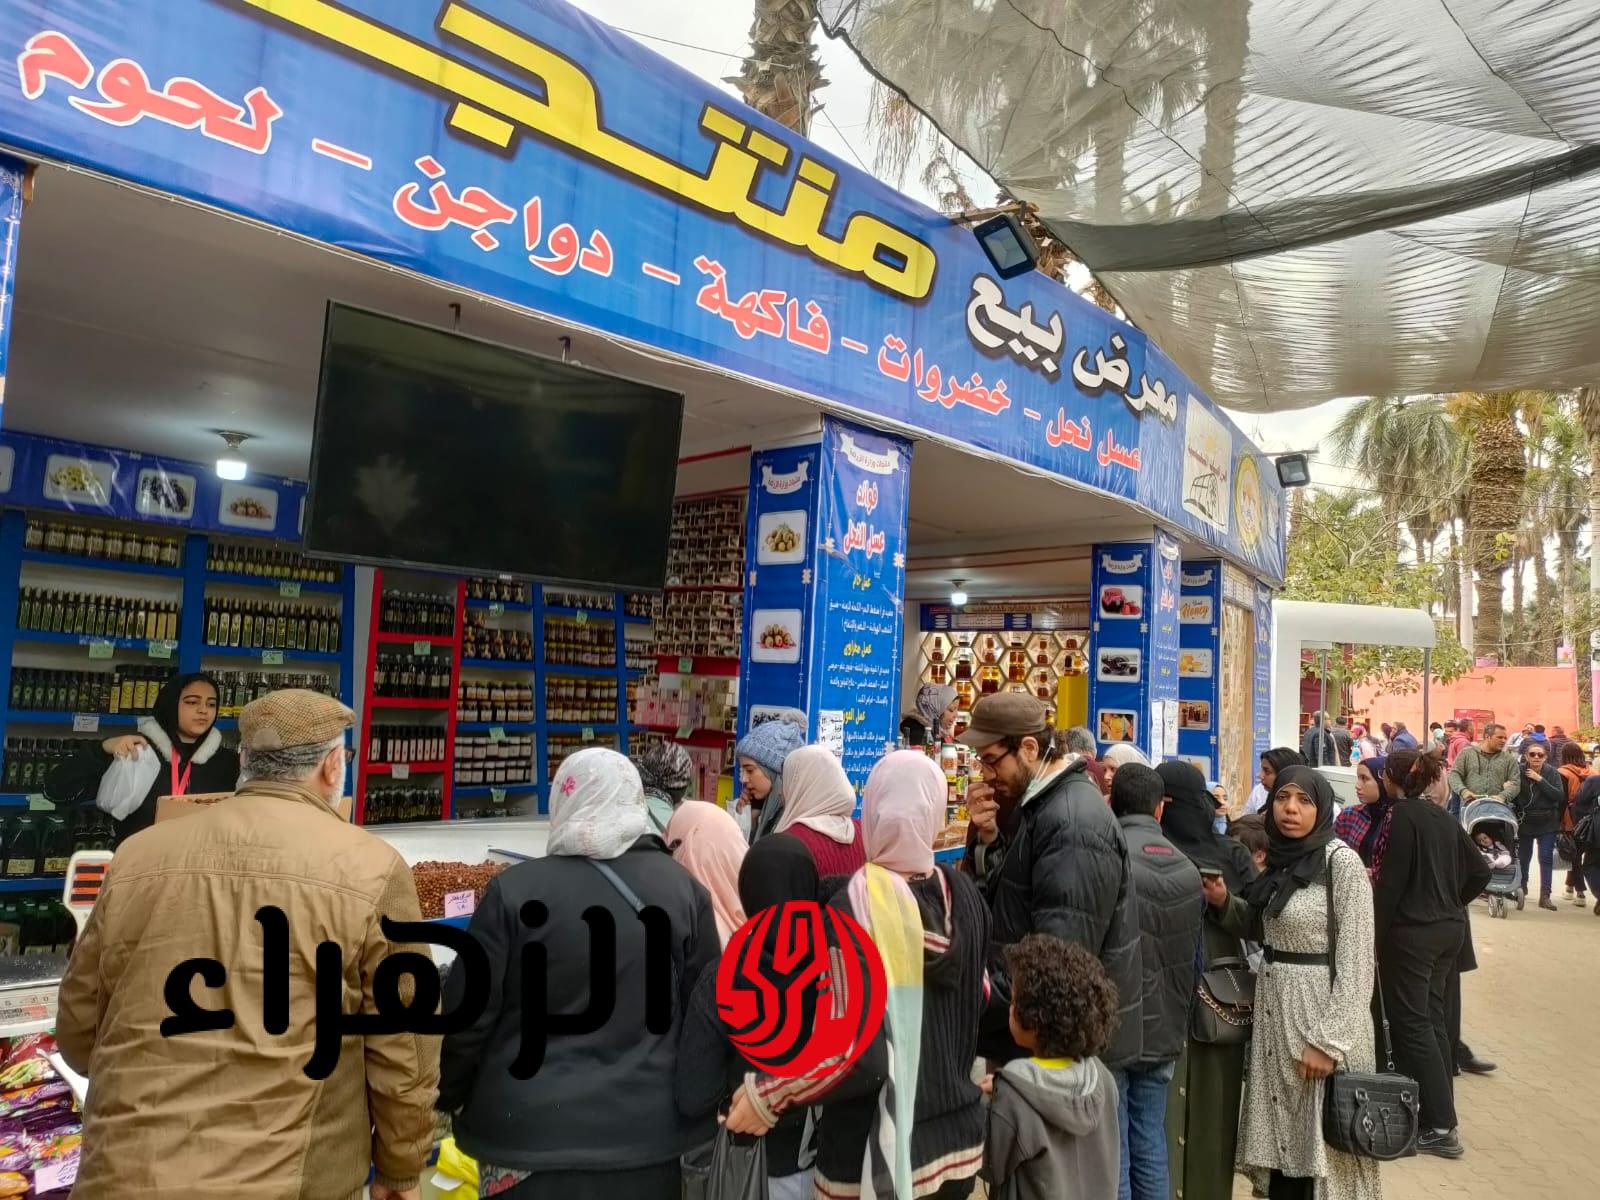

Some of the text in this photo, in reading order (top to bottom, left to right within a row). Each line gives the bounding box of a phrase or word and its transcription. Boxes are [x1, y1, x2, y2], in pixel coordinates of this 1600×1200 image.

[17, 30, 1142, 471] عسل نحل خضروات فاكهة دواجن لحوم
[241, 0, 1179, 423] معرض بيع منتج
[843, 518, 885, 560] عسل النحل
[855, 479, 879, 516] فوائد
